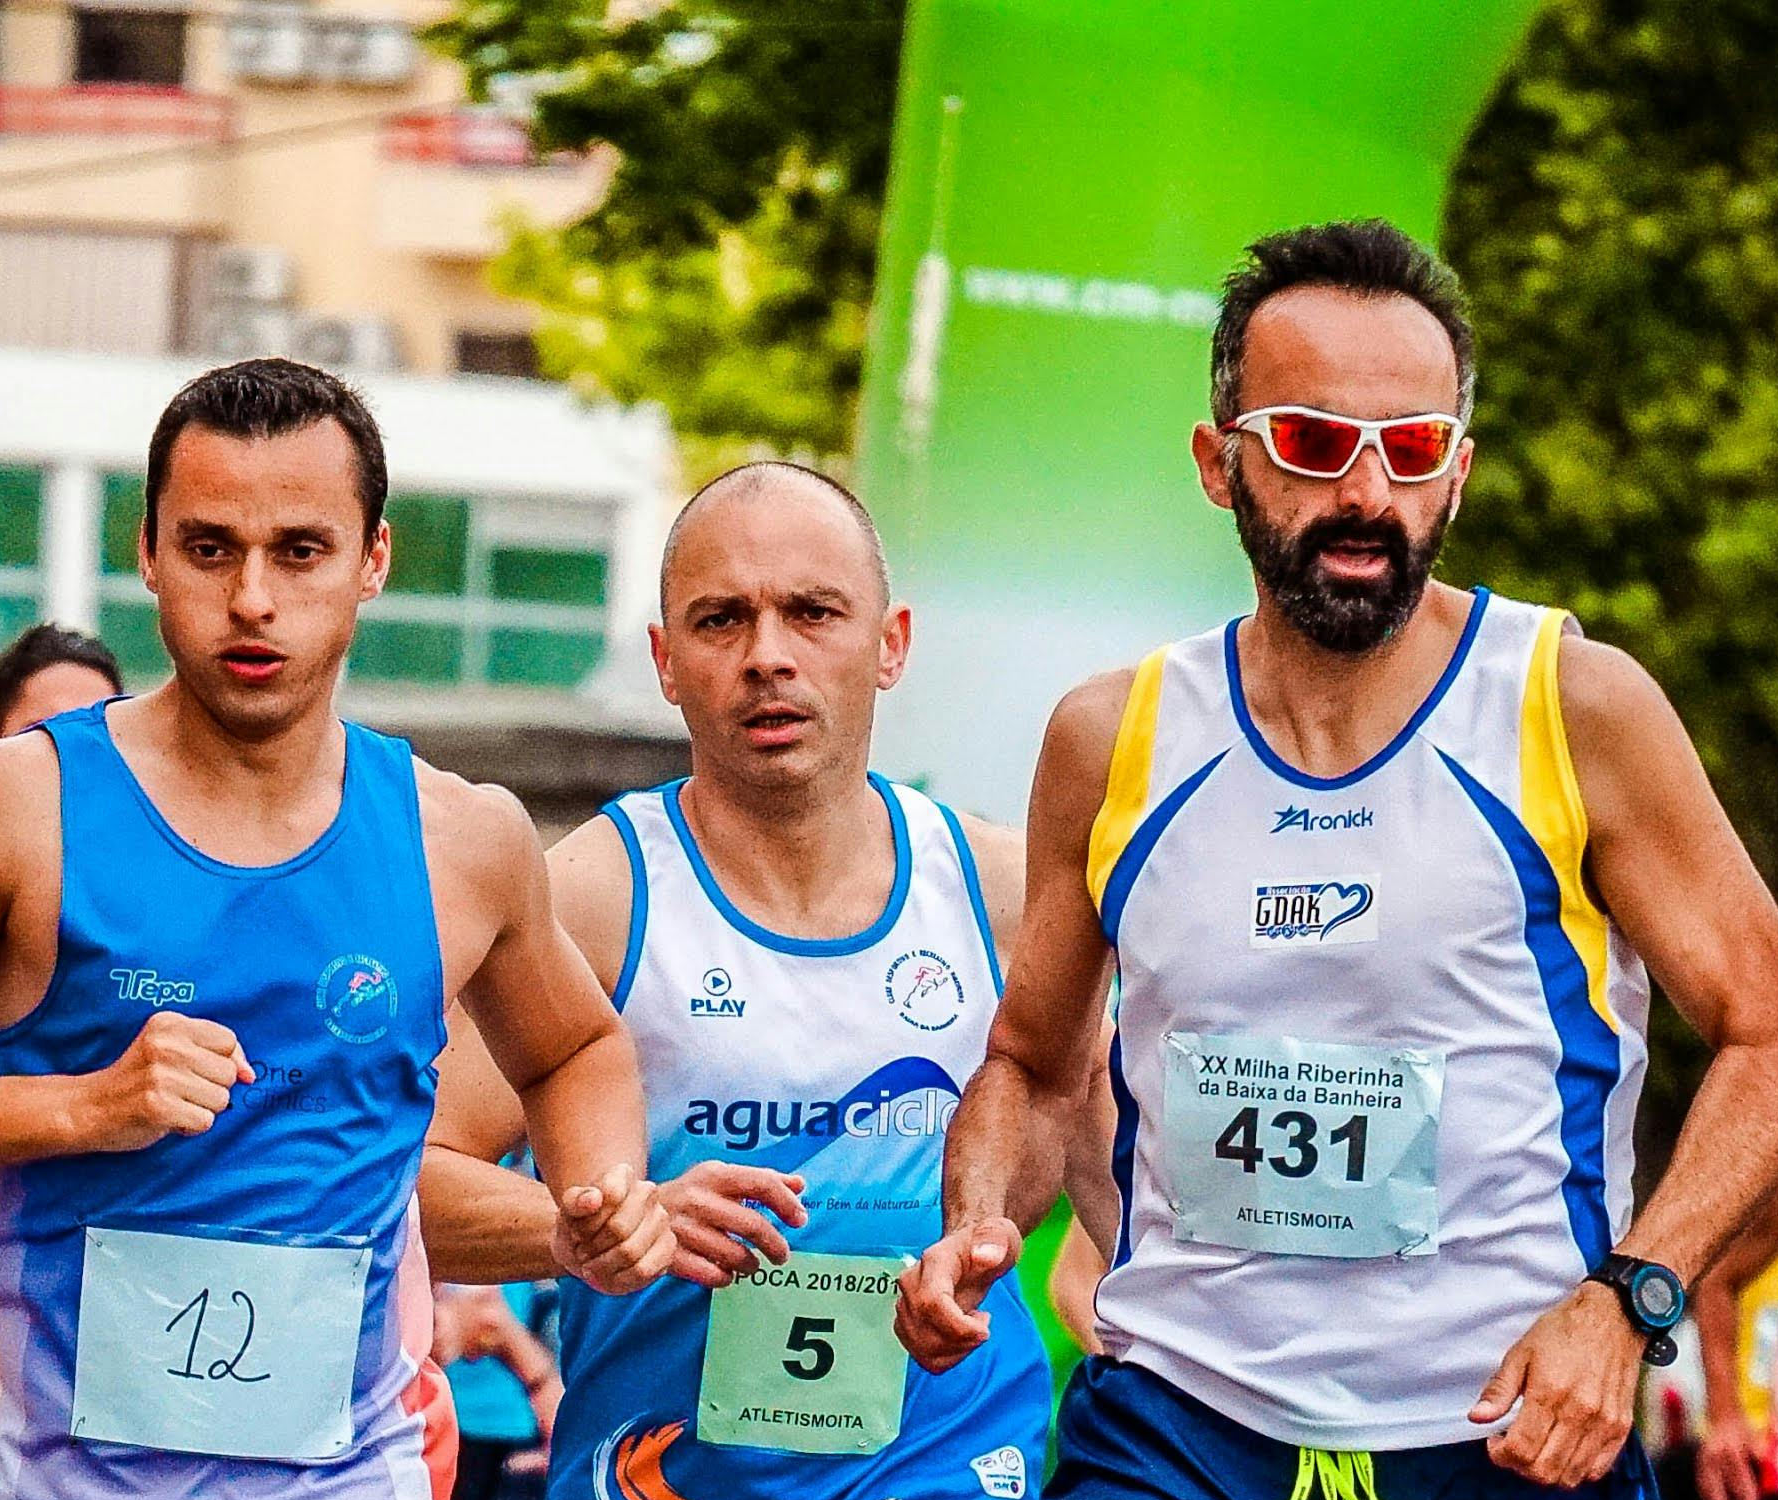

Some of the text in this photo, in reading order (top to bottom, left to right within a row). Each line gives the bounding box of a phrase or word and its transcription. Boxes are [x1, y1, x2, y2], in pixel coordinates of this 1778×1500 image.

[1270, 806, 1374, 834] Aronick
[1256, 895, 1321, 927] GDAK
[691, 998, 746, 1017] PLAY
[1199, 1055, 1404, 1088] XX Milha Riberinha
[243, 1086, 331, 1114] Clinics
[1198, 1079, 1403, 1109] da Baixa da Banheira
[1214, 1106, 1369, 1182] 431
[826, 1197, 852, 1210] Bem
[855, 1198, 869, 1210] da
[873, 1197, 920, 1211] Natureza
[1236, 1206, 1355, 1231] ATLETISMOITA
[734, 1267, 899, 1294] POCA 2018/201
[165, 1287, 271, 1383] 12
[782, 1316, 836, 1381] 5
[738, 1407, 864, 1430] ATLETISMOITA
